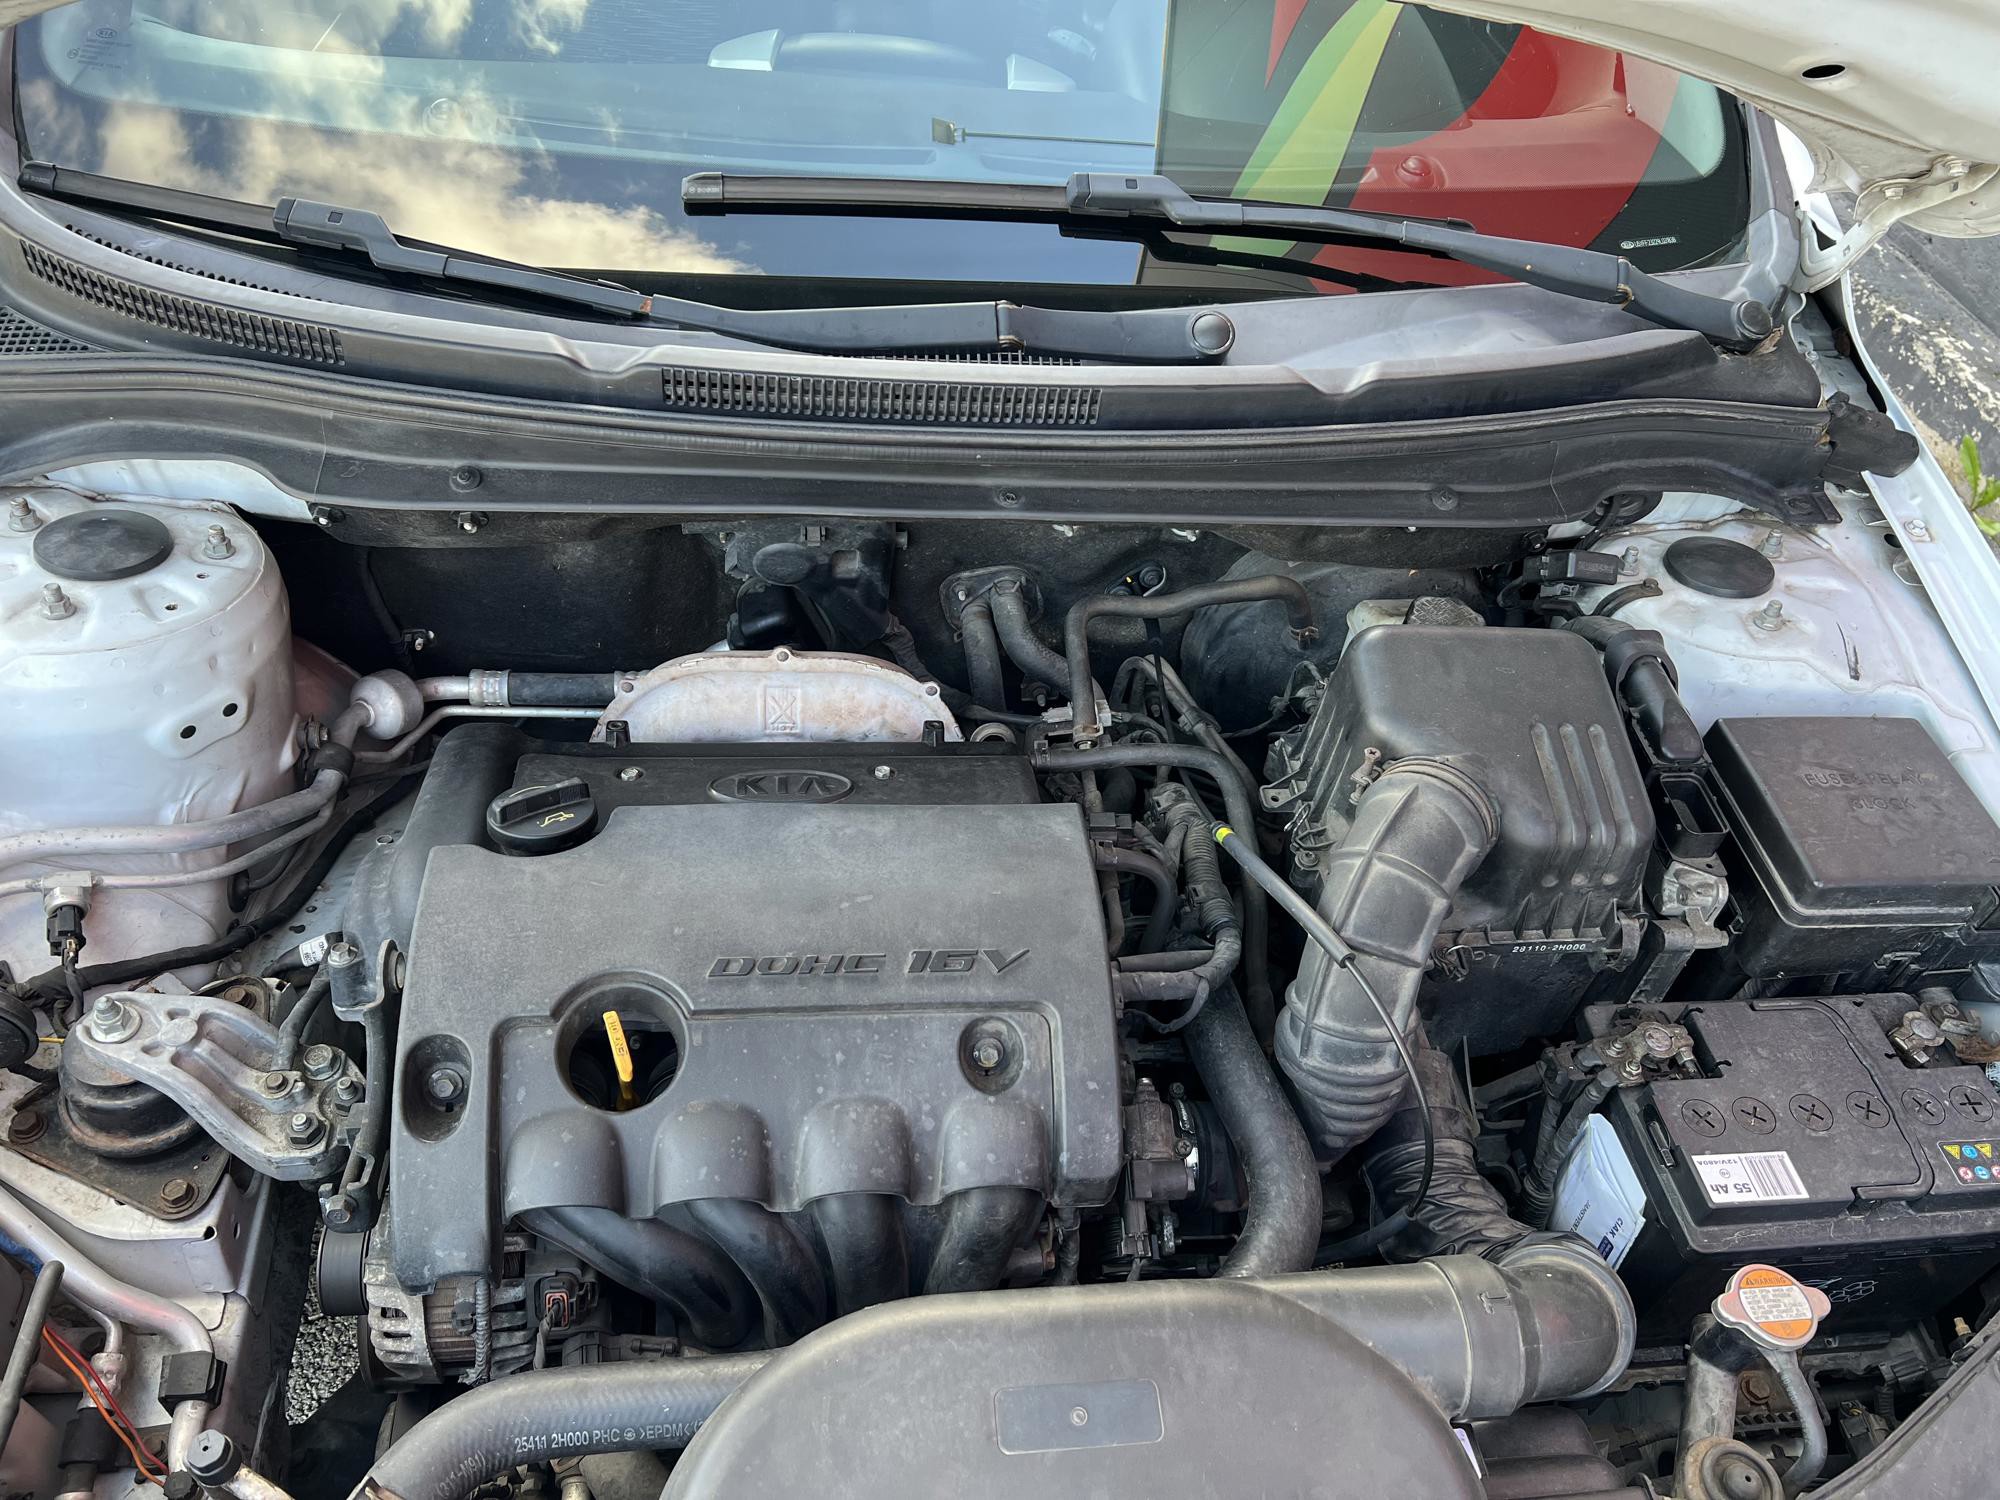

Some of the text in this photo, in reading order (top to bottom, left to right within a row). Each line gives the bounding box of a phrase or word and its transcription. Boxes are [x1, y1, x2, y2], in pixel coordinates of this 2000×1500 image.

[735, 775, 831, 797] KIA
[1803, 772, 1850, 788] FUSE
[1849, 797, 1917, 811] BLOCK
[1512, 943, 1586, 953] 28110-2H000
[705, 948, 1030, 978] DOHC 16V
[1710, 1182, 1752, 1194] 55 Ah
[514, 1435, 547, 1453] 25411
[551, 1431, 589, 1448] 2H000
[592, 1428, 620, 1443] PHC
